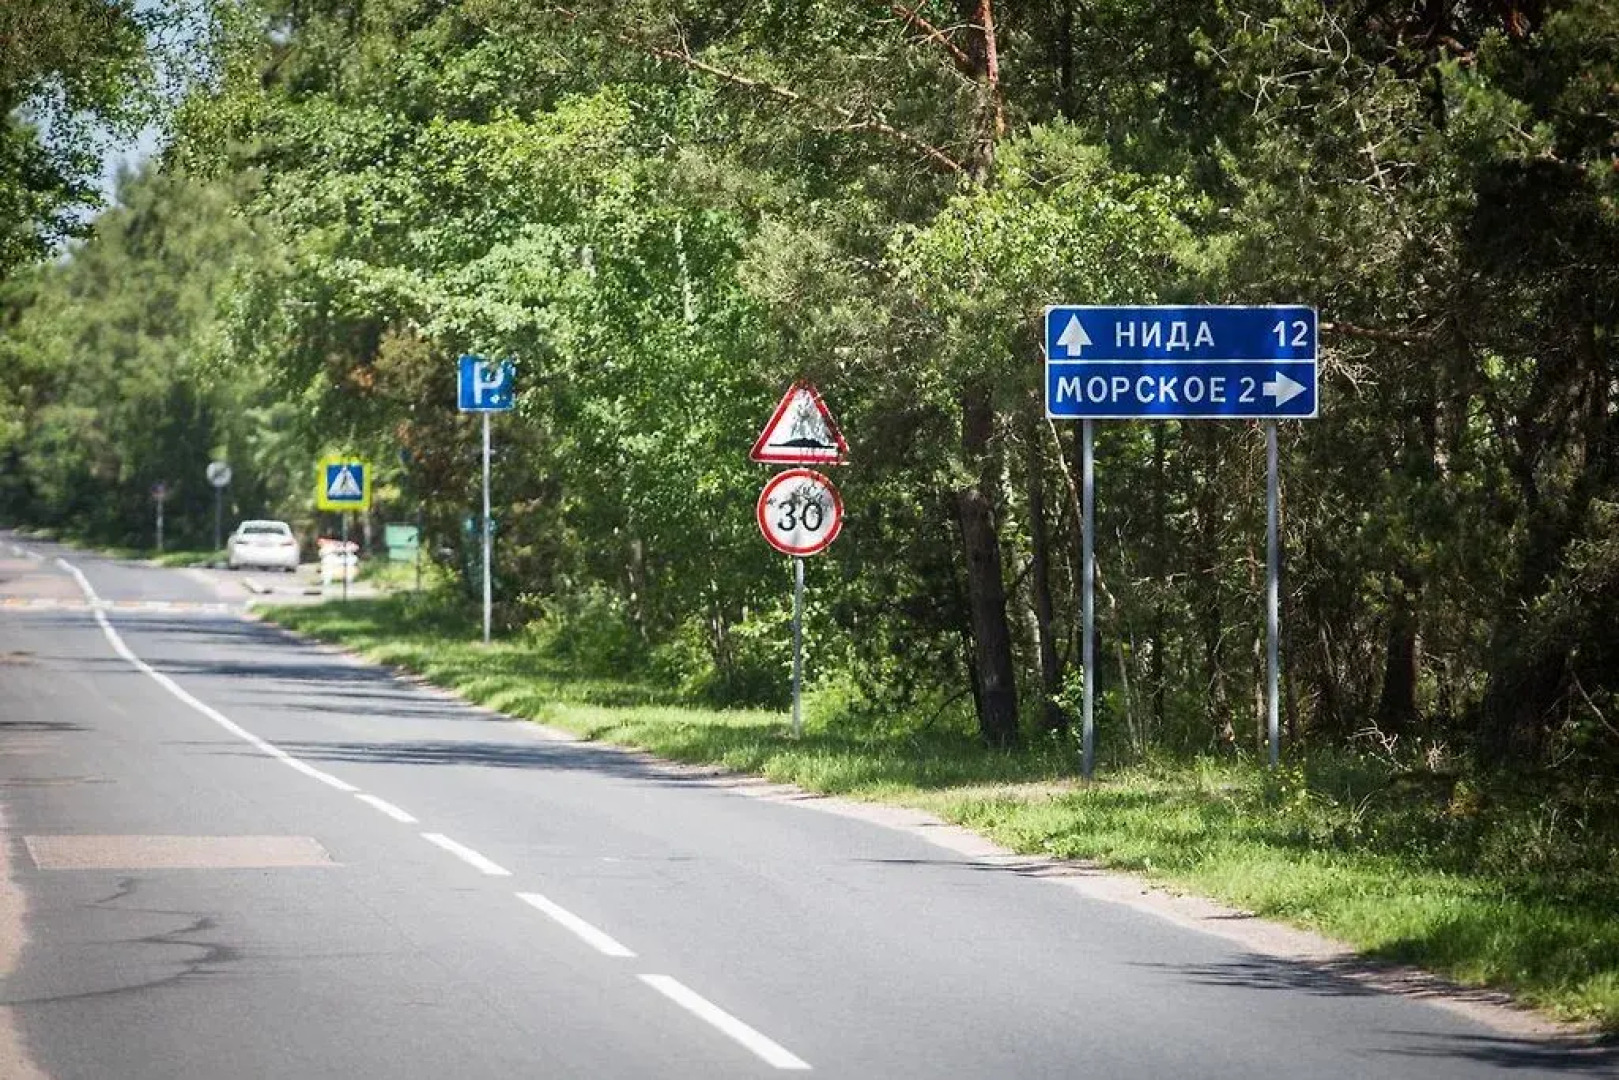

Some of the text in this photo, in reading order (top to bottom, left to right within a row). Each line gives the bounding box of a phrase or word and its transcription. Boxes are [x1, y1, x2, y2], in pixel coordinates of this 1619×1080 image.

[1115, 320, 1308, 351] НИДА 12
[1056, 376, 1256, 403] МОРСКОЕ 2
[777, 501, 823, 532] 30
